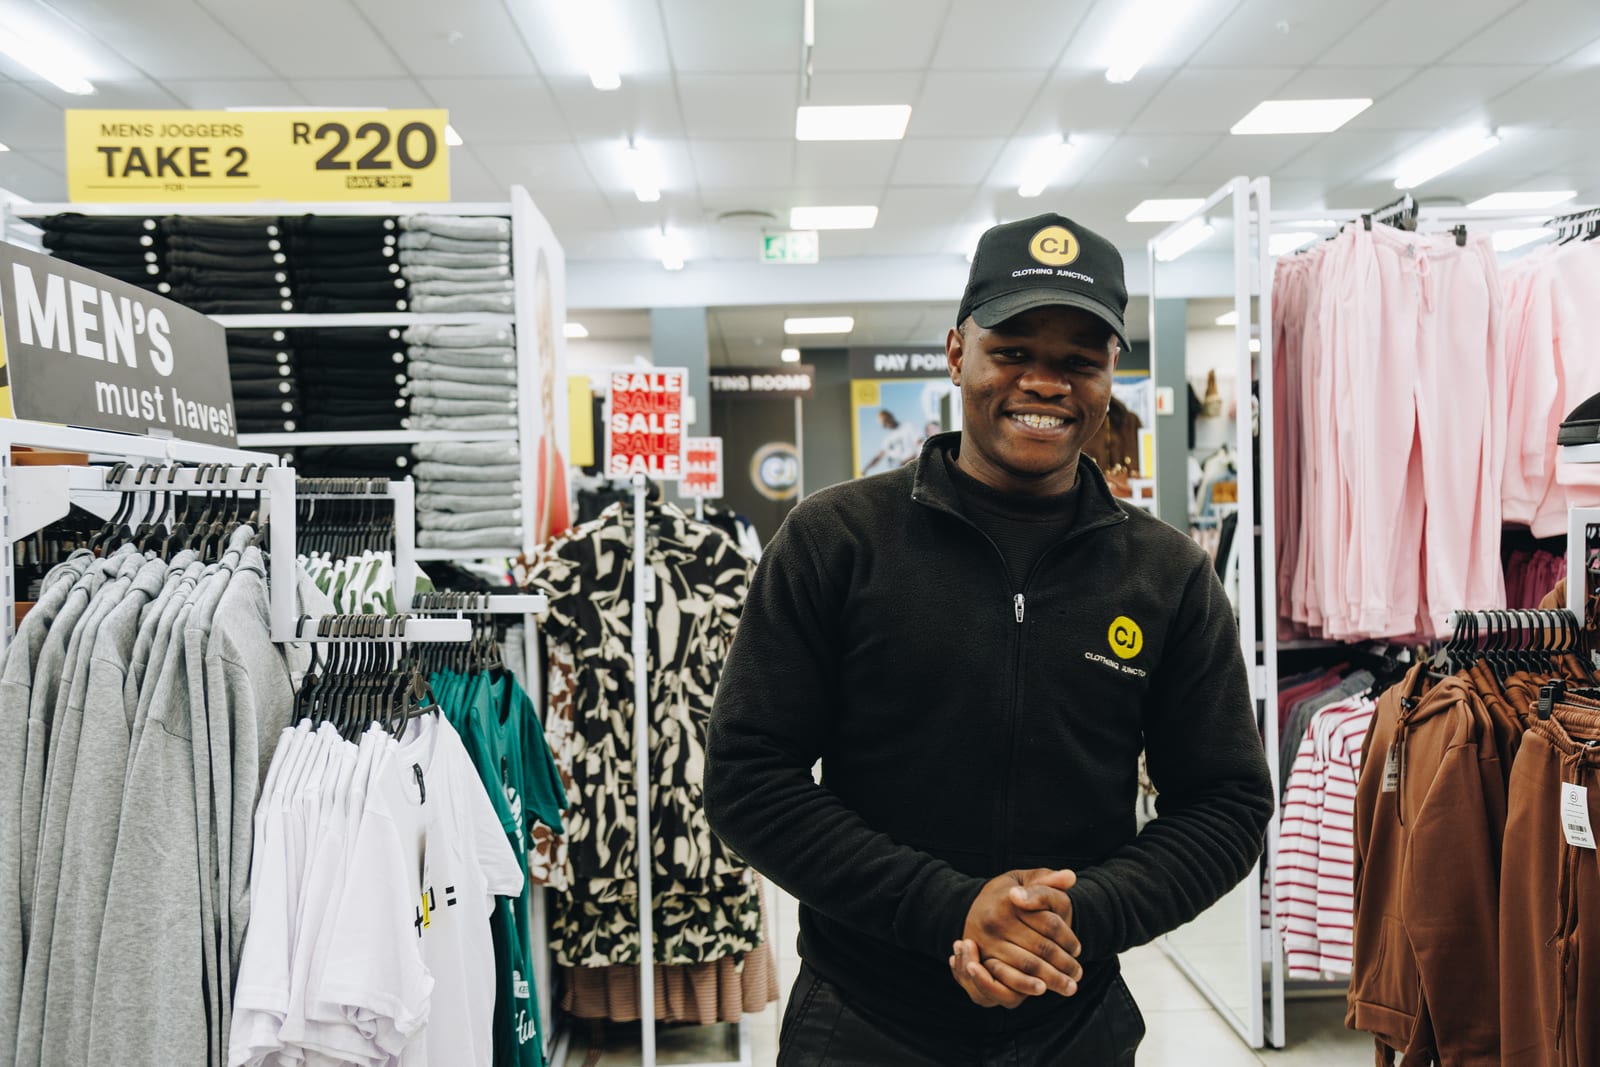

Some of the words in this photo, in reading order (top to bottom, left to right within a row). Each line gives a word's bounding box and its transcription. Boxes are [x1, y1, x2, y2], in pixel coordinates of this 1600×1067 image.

[100, 124, 154, 138] MENS
[160, 124, 244, 138] JOGGERS
[96, 146, 212, 178] TAKE
[225, 146, 249, 178] 2
[1040, 237, 1069, 255] CJ
[1012, 268, 1053, 277] CLOTHING
[1056, 269, 1094, 284] JUNCTION
[12, 262, 174, 377] MEN'S
[874, 353, 908, 371] PAY
[612, 373, 681, 392] SALE
[707, 375, 750, 391] TING
[750, 374, 811, 391] ROOMS
[95, 380, 167, 423] must
[172, 387, 235, 437] haves!
[612, 391, 681, 414] SALE
[612, 412, 681, 434] SALE
[612, 433, 681, 455] SALE
[612, 453, 681, 475] SALE
[1114, 626, 1136, 649] CJ
[1084, 652, 1119, 670] CLOTHING
